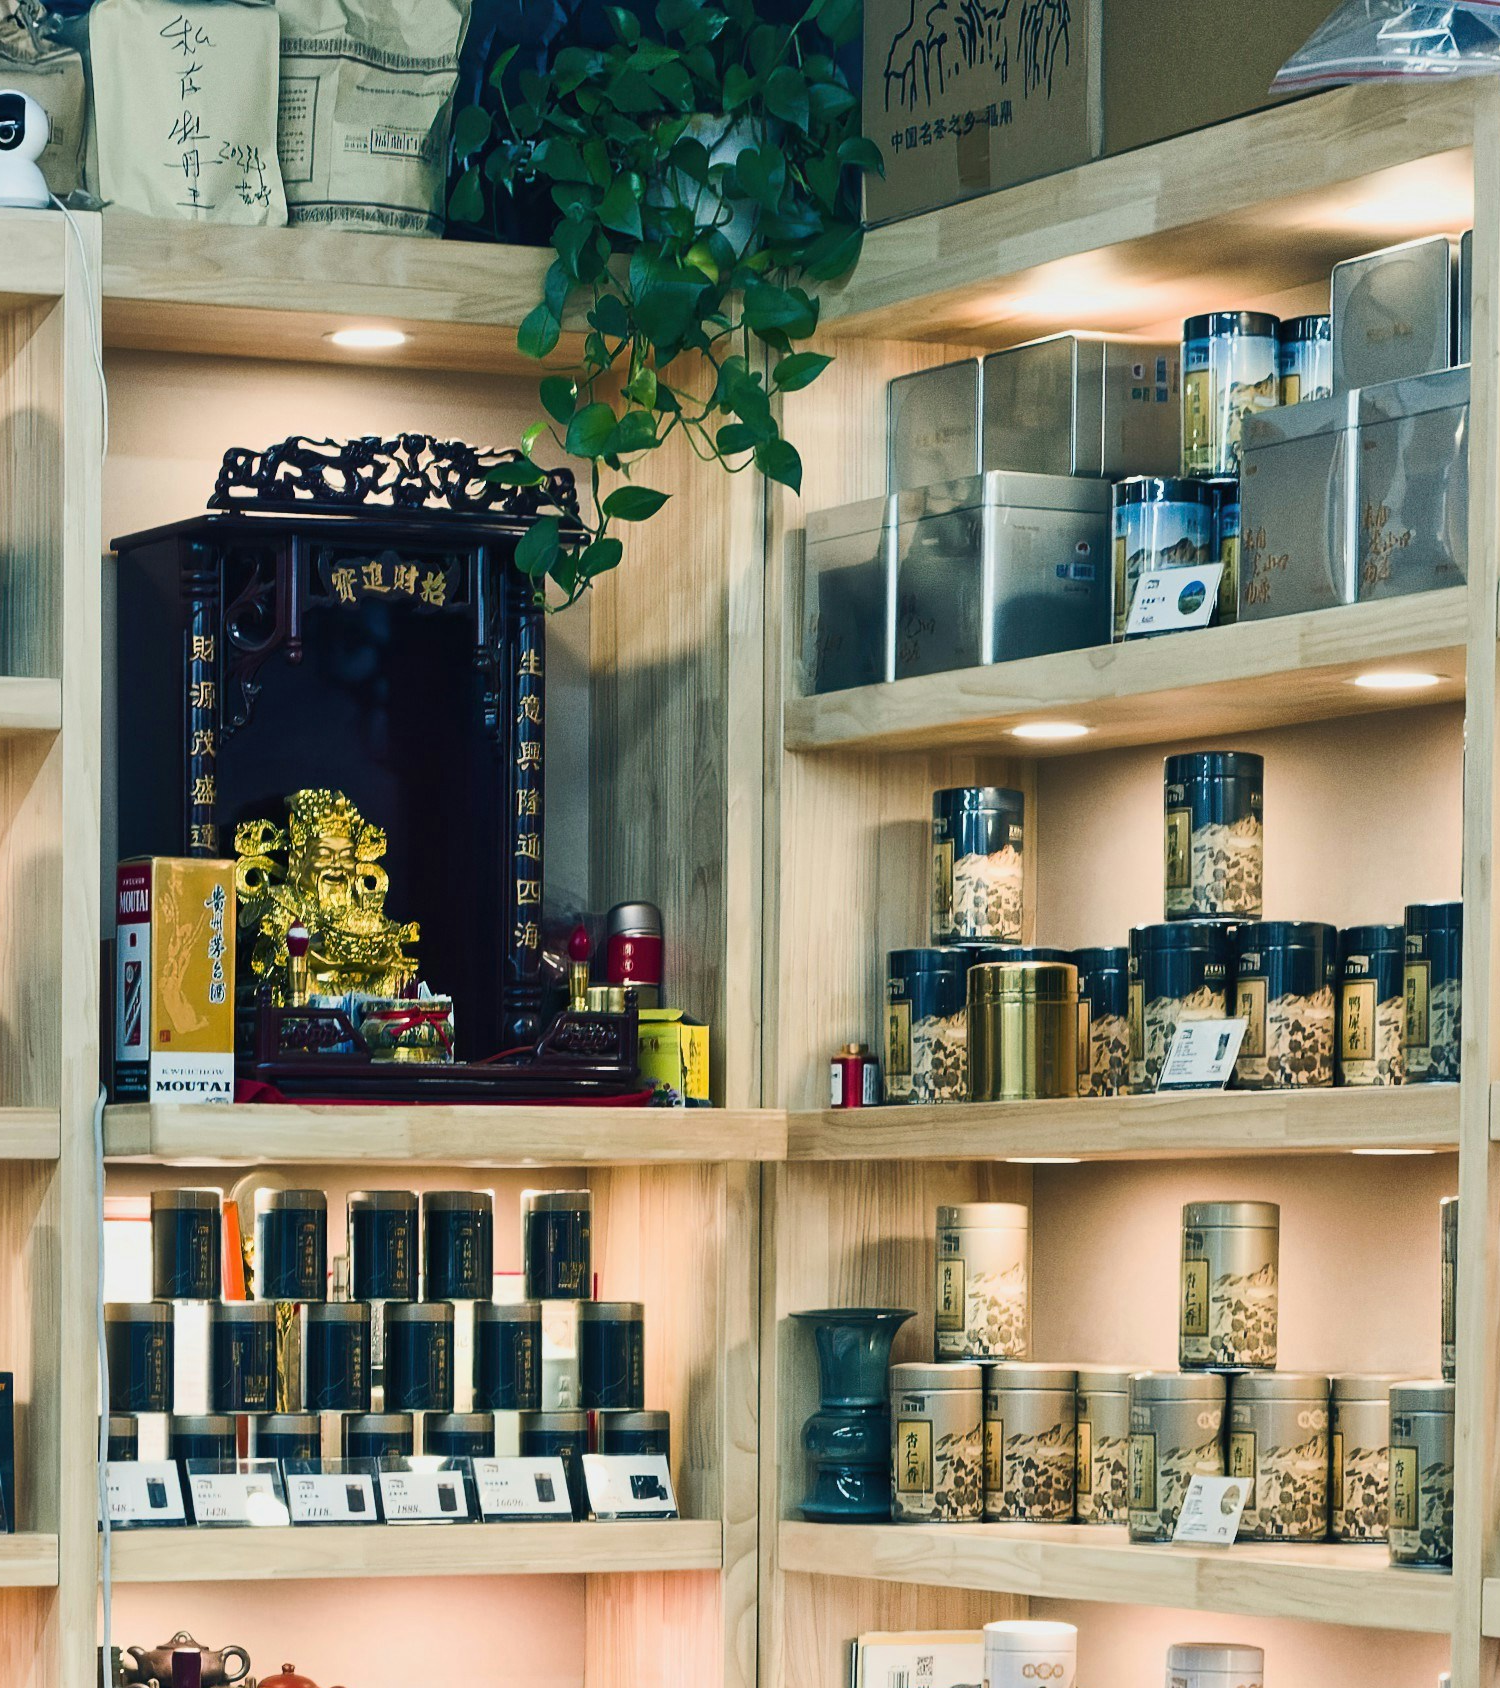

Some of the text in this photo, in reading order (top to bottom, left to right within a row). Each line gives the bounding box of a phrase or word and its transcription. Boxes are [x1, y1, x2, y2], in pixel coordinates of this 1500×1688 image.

[119, 888, 149, 915] MOUTAI
[203, 882, 227, 1005] 贵州茅台酒
[1348, 995, 1361, 1051] 鸭屎香
[155, 1080, 232, 1094] MOUTAI
[904, 1431, 919, 1485] 杏仁香
